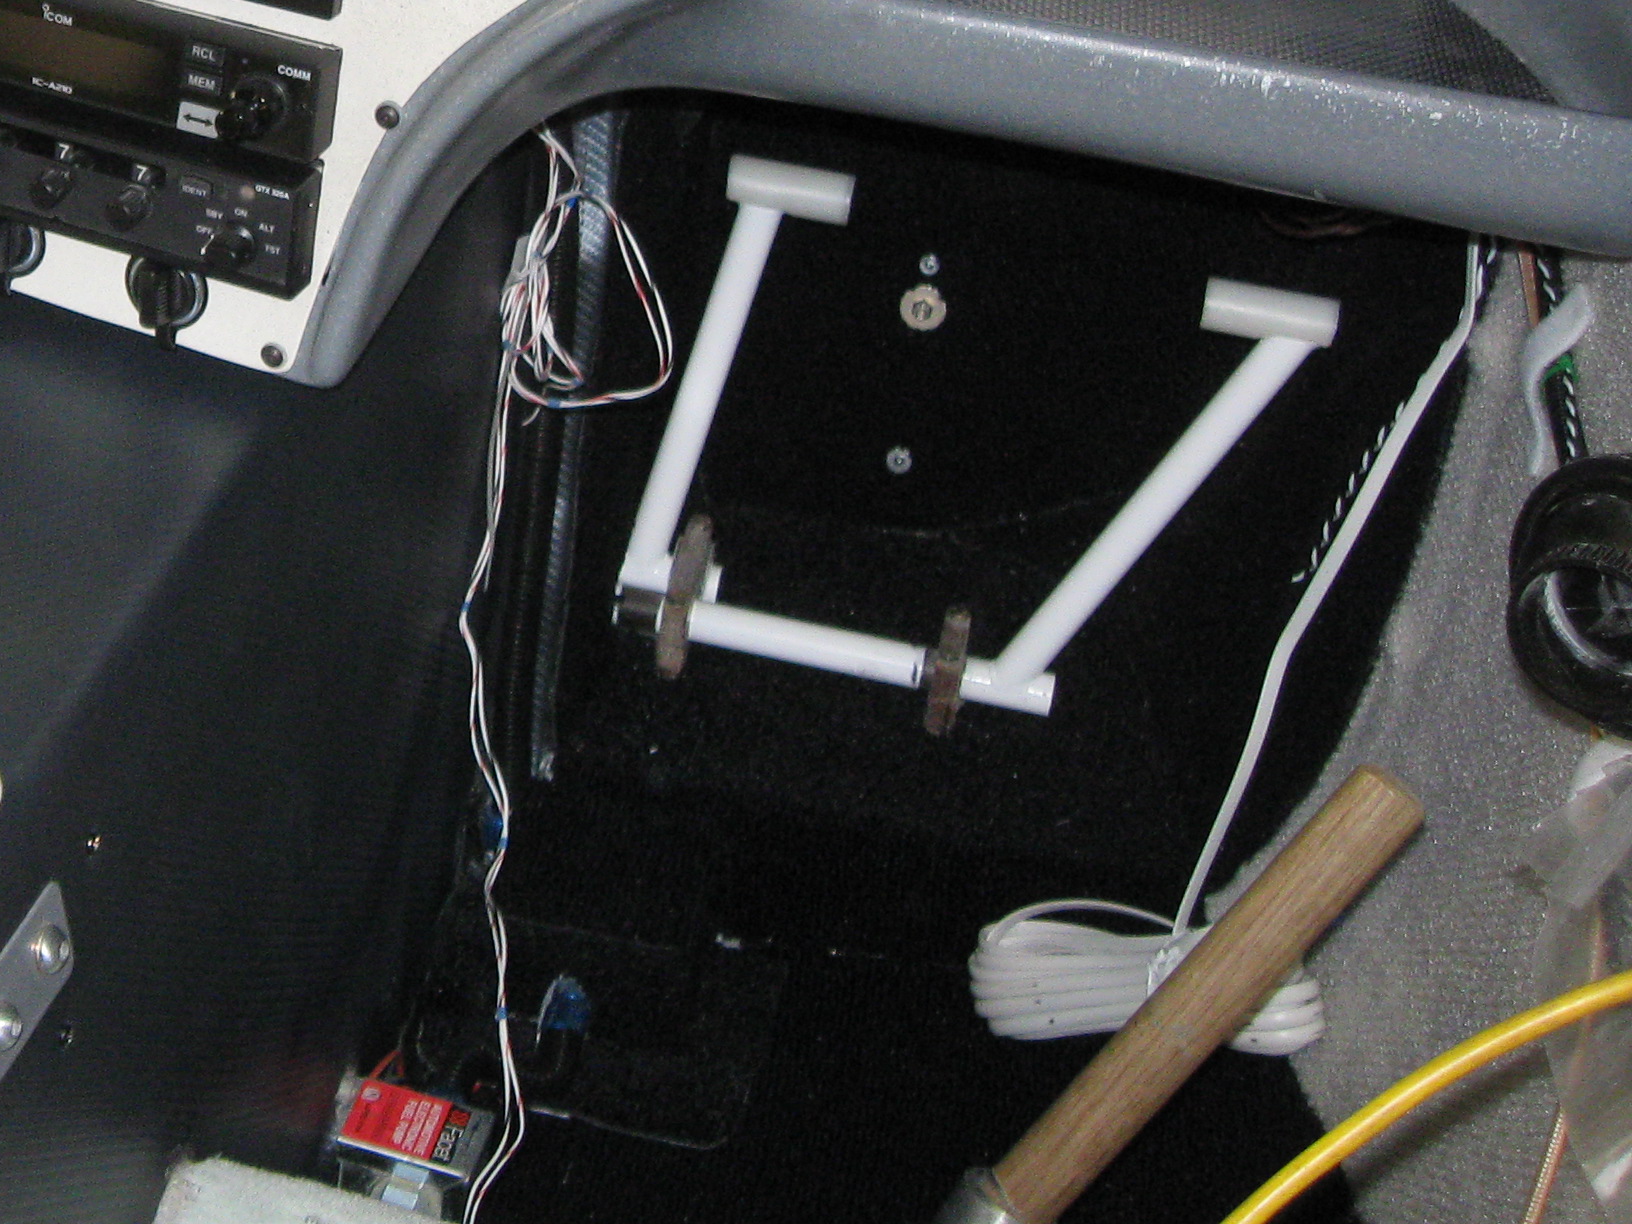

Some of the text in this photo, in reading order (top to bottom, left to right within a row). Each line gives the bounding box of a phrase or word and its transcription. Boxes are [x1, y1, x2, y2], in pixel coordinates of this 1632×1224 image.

[192, 44, 217, 62] RCL
[277, 64, 312, 82] COMM
[31, 76, 73, 95] IC-A210
[188, 73, 216, 92] MEM
[58, 143, 70, 160] 7
[136, 164, 148, 182] 7
[182, 184, 207, 197] IDENT
[255, 184, 271, 196] GTX
[234, 207, 248, 218] ON
[195, 225, 213, 235] OFF
[258, 223, 275, 234] ALT
